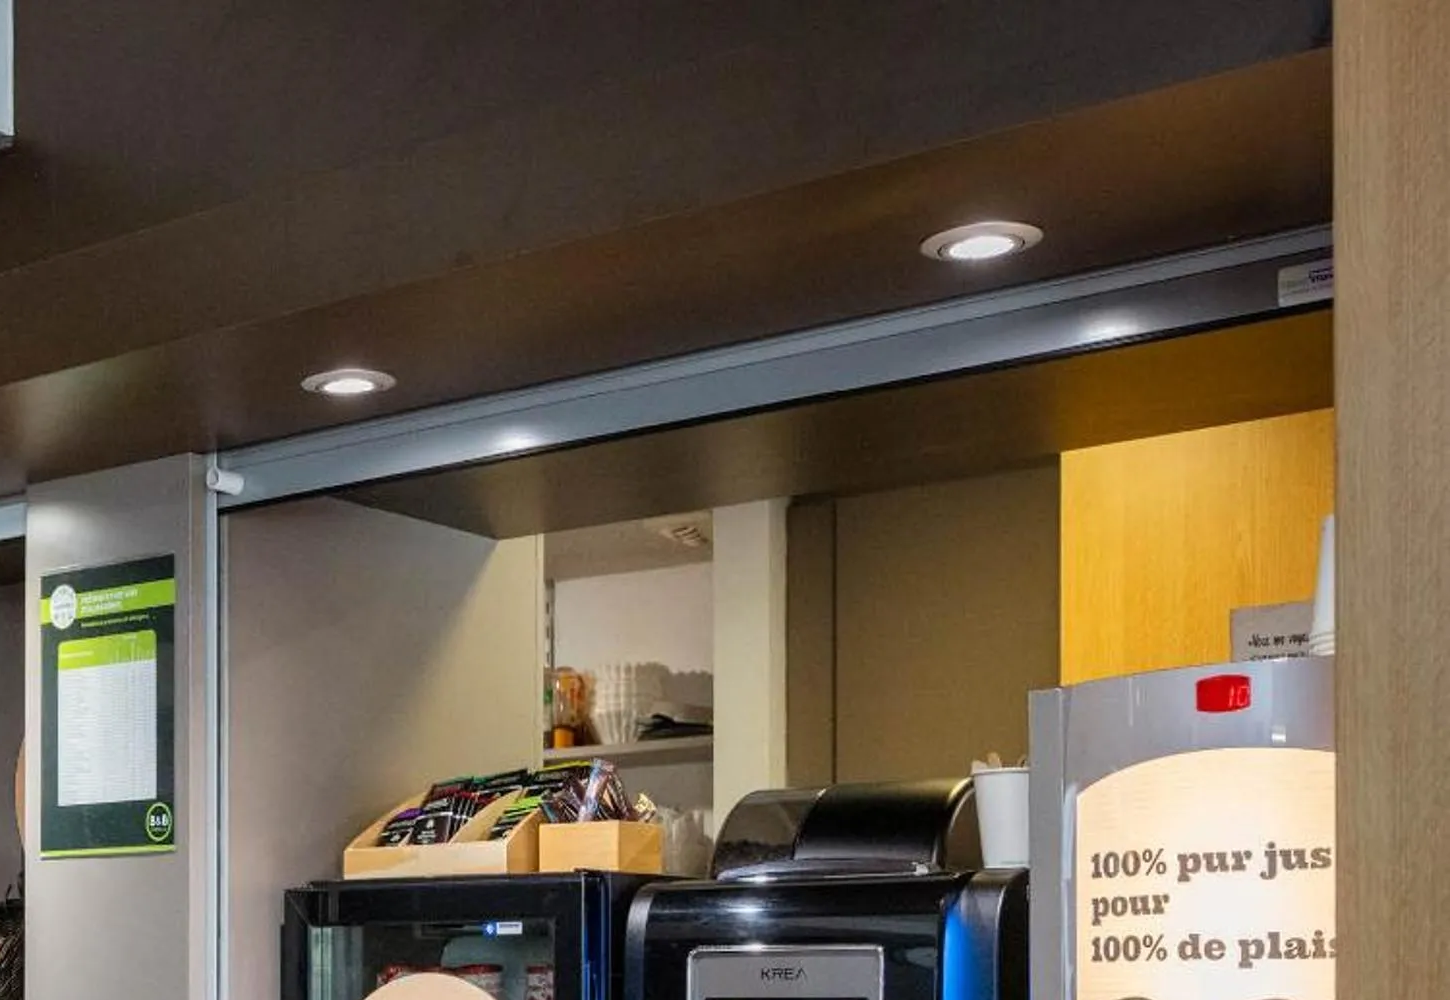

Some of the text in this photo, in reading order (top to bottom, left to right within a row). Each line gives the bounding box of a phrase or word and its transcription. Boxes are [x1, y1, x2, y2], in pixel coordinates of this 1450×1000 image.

[1090, 841, 1332, 882] 100% pur jus
[1090, 892, 1170, 926] pour
[1090, 933, 1167, 963] 100%
[1177, 932, 1226, 961] de
[761, 967, 808, 981] KREA
